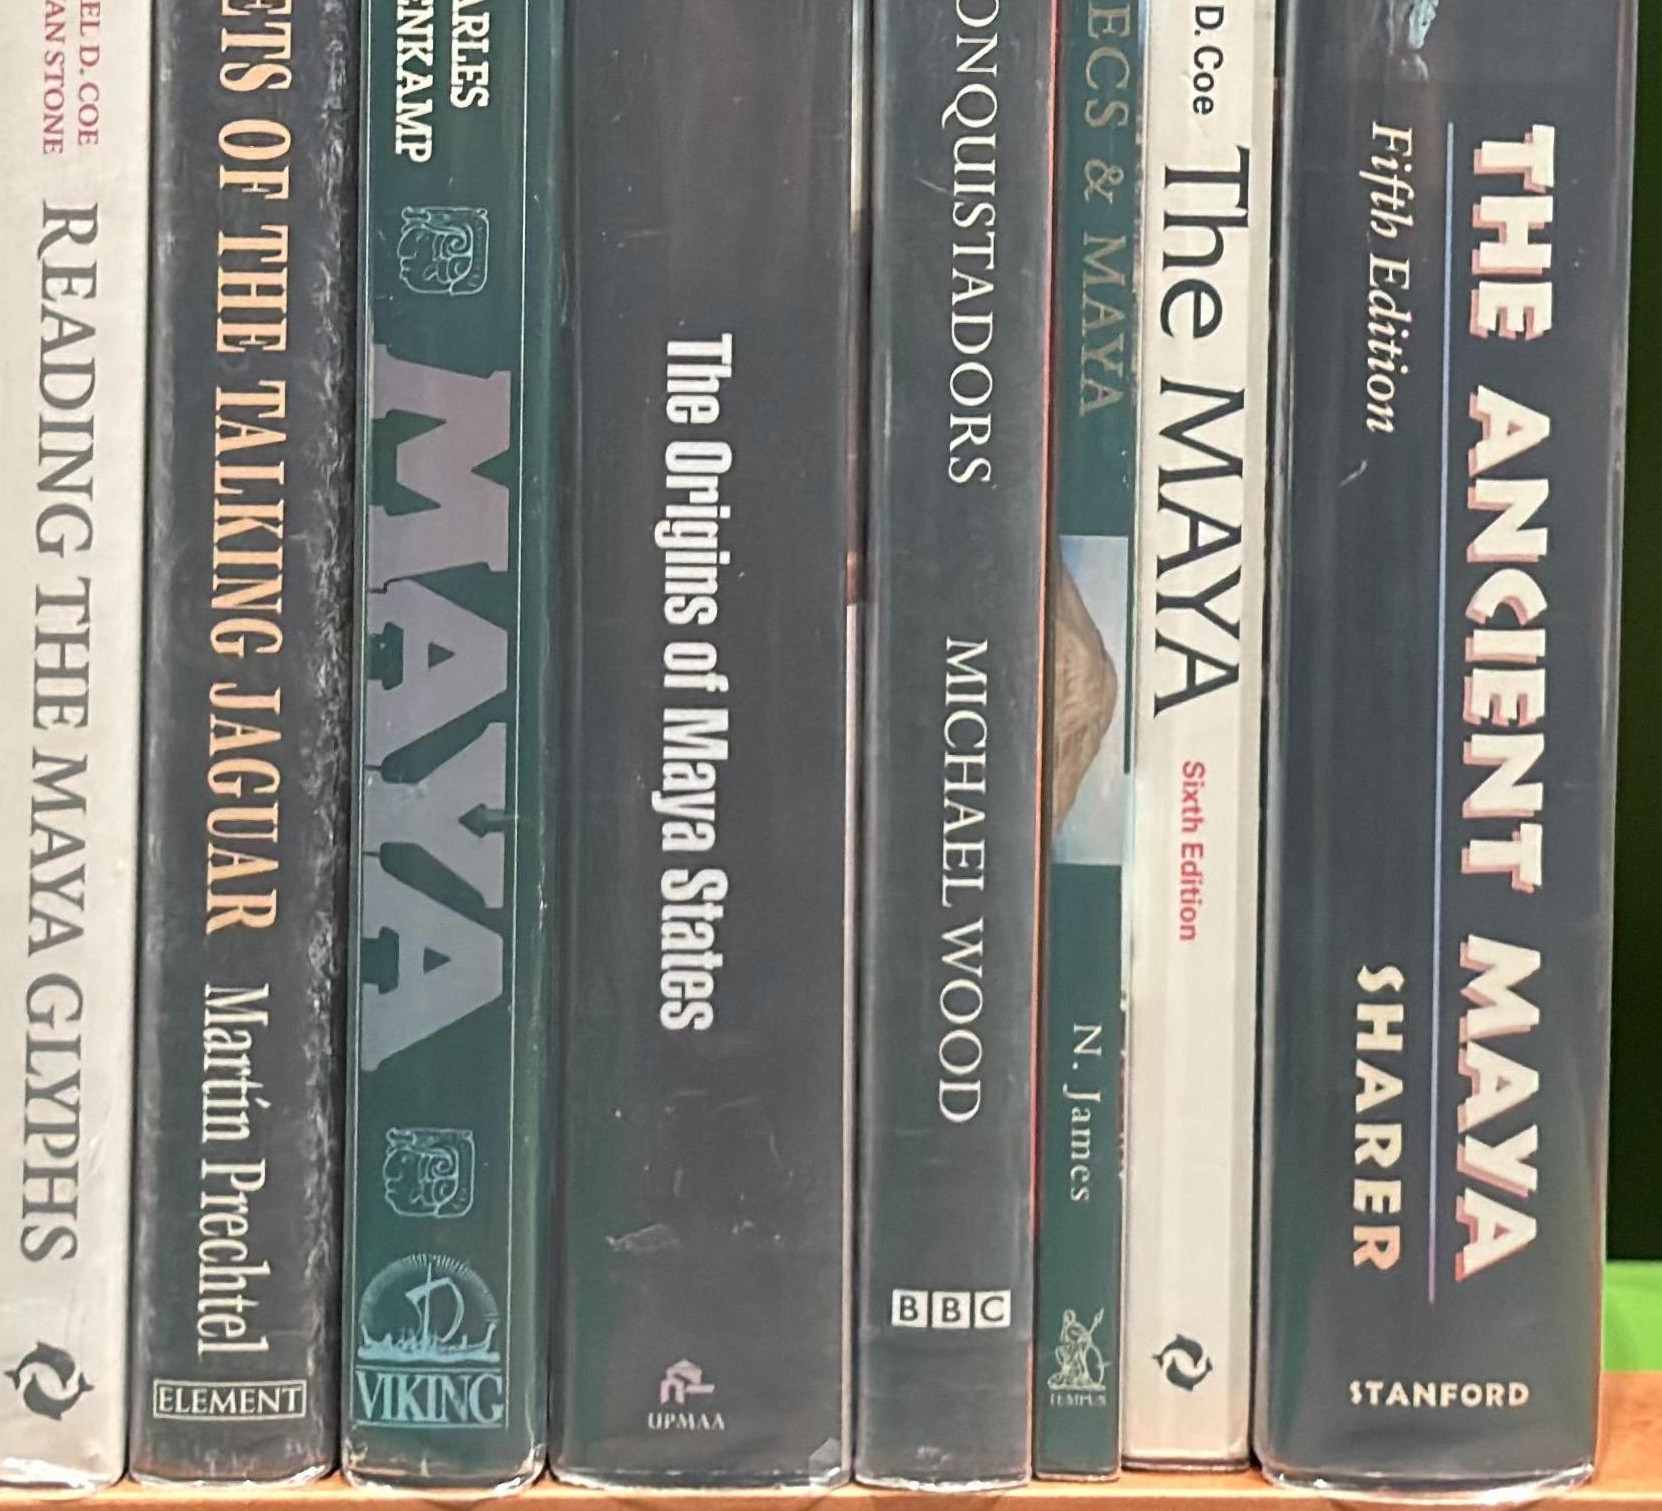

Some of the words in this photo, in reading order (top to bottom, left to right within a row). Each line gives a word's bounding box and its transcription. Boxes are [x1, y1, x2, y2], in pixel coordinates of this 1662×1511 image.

[78, 44, 100, 75] D.
[1192, 45, 1224, 116] Coe
[1194, 5, 1224, 38] D.
[42, 49, 65, 155] STONE
[77, 81, 99, 146] COE
[217, 119, 293, 200] OF
[1083, 158, 1124, 204] &
[1159, 145, 1252, 340] The
[1368, 121, 1414, 240] Fifth
[1470, 124, 1558, 342] THE
[216, 225, 290, 355] THE
[1080, 235, 1127, 416] MAYA
[1366, 252, 1414, 434] Edition
[36, 200, 99, 556] READING
[664, 333, 733, 425] The
[209, 380, 286, 657] TALKING
[653, 441, 732, 627] Origins
[1154, 375, 1245, 718] MAYA
[31, 581, 90, 729] THE
[360, 342, 512, 1070] MAYA
[663, 642, 729, 691] of
[1462, 384, 1554, 894] ANCIENT
[204, 681, 283, 936] JAGUAR
[651, 708, 729, 852] Maya
[943, 635, 987, 908] MICHAEL
[1180, 759, 1207, 834] Sixth
[26, 746, 88, 959] MAYA
[1179, 840, 1204, 943] Edition
[659, 869, 729, 1031] States
[938, 918, 986, 1126] WOOD
[21, 975, 86, 1264] GLYPHS
[203, 983, 270, 1142] Martín
[1070, 1023, 1103, 1074] N.
[1352, 964, 1406, 1269] SHARER
[1454, 934, 1544, 1282] MAYA
[1063, 1083, 1101, 1202] James
[195, 1158, 270, 1357] Prechtel
[894, 1293, 1008, 1326] BBC
[158, 1385, 302, 1414] ELEMENT
[357, 1372, 504, 1423] VIKING
[647, 1412, 726, 1432] UPMAA
[1350, 1381, 1530, 1408] STANFORD
